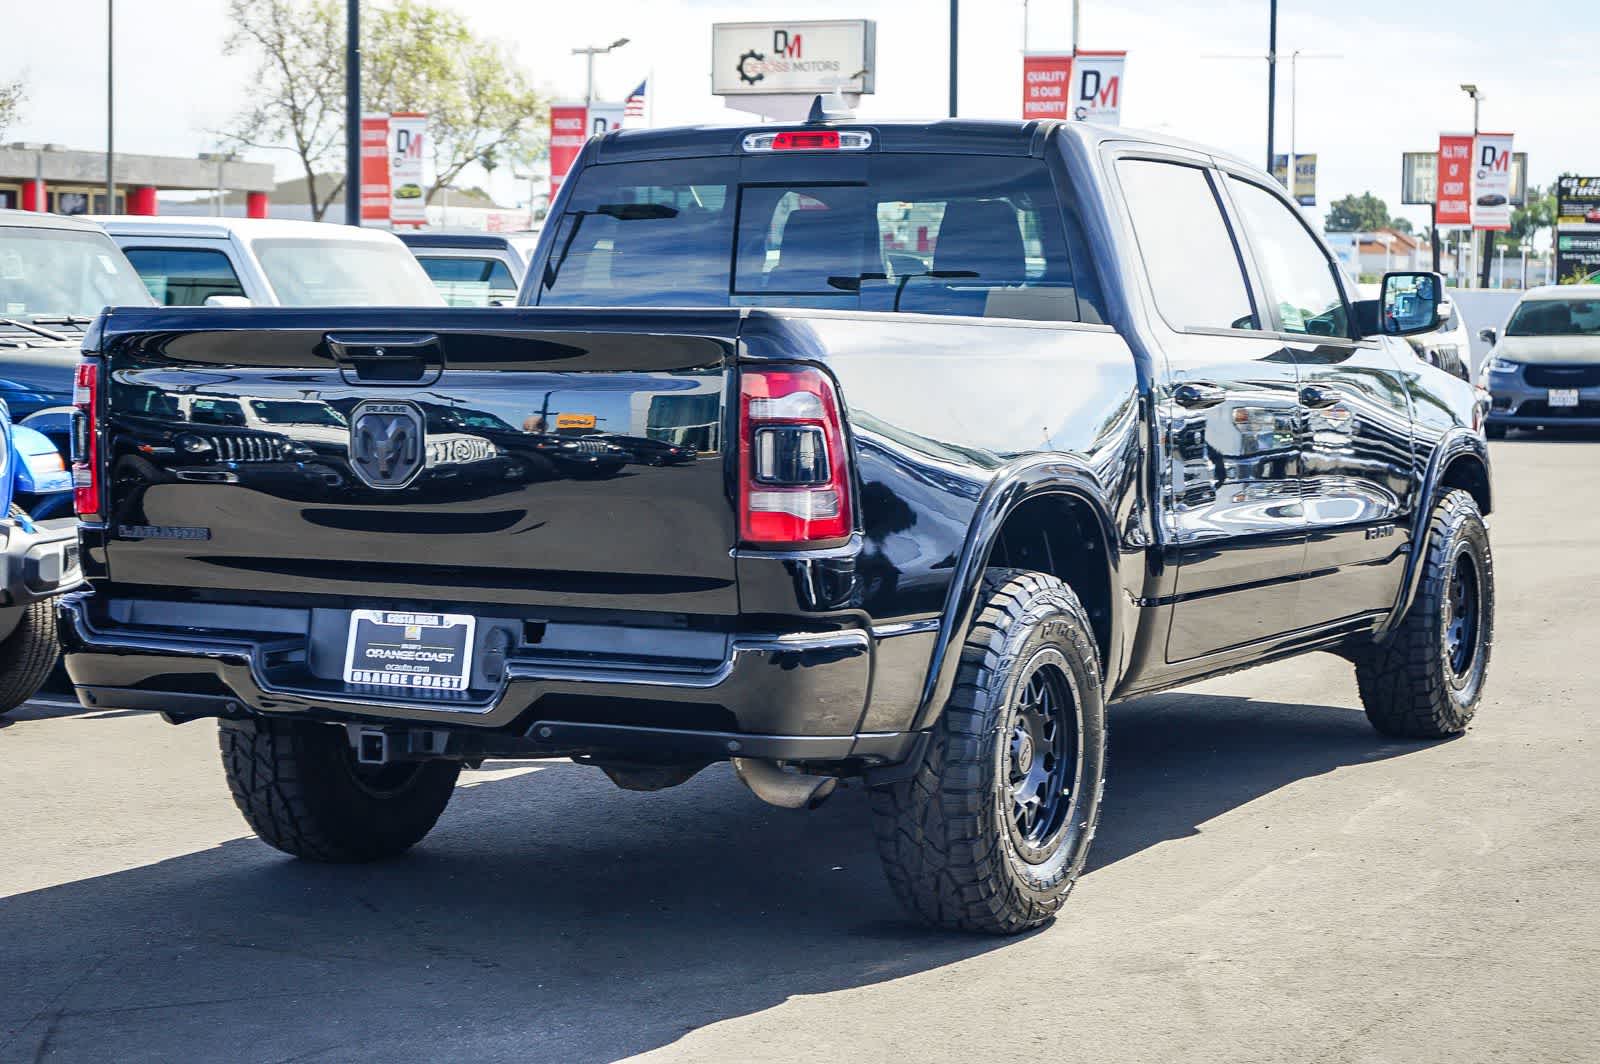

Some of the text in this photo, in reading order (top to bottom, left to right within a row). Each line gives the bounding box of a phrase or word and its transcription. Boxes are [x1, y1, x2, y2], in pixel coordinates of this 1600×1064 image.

[774, 30, 803, 58] DM
[792, 61, 840, 72] MOTORS
[1026, 71, 1067, 82] QUALITY
[1080, 70, 1120, 108] DM
[1481, 146, 1510, 172] DM
[416, 651, 455, 663] COAST
[412, 676, 460, 688] COAST
